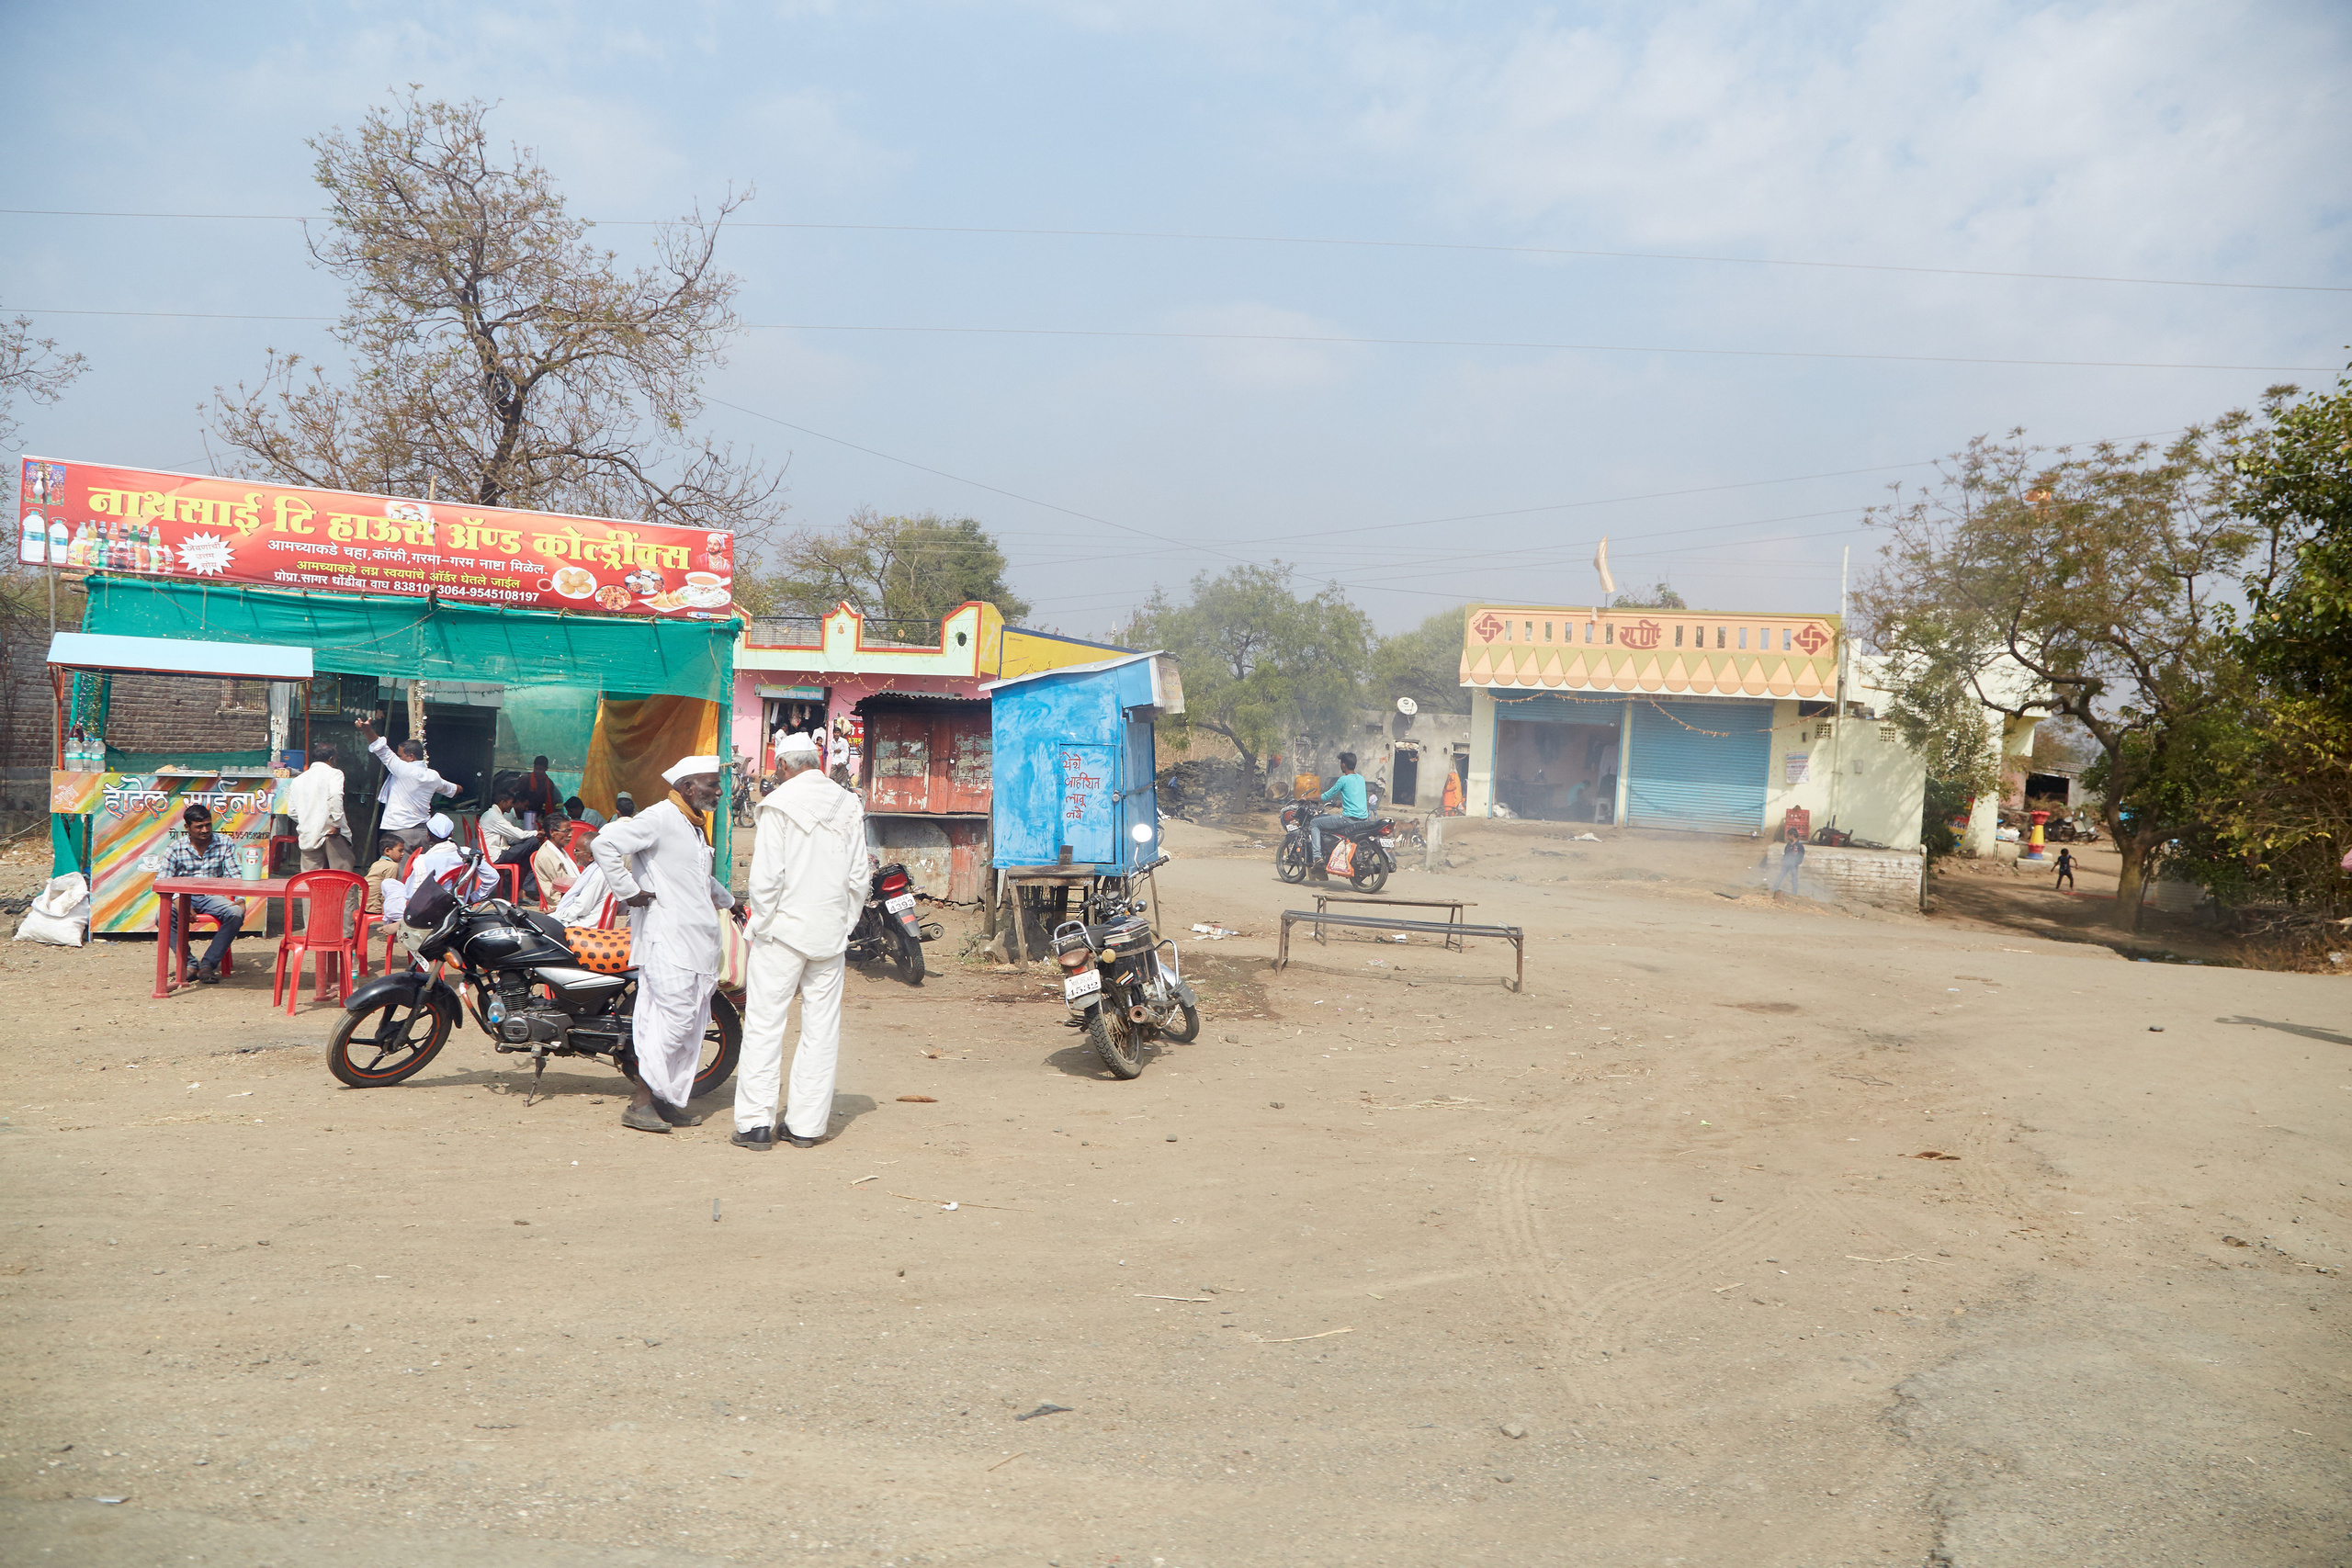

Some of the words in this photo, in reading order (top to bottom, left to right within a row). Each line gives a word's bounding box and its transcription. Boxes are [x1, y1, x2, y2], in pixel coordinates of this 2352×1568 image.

[88, 486, 266, 537] नाथसाई
[273, 494, 320, 535] टि
[267, 538, 339, 556] आमच्याकडे
[510, 558, 548, 575] मिळेल.
[296, 559, 357, 574] आमच्याकडे
[360, 565, 379, 577] लग्न
[460, 571, 488, 586] घेतले
[490, 576, 521, 590] जाईल
[370, 579, 390, 590] वाघ
[393, 581, 540, 603] 838103064-9545108197
[102, 774, 169, 820] हॉटेल
[180, 780, 276, 823] साईनाथ
[890, 898, 914, 912] 4393
